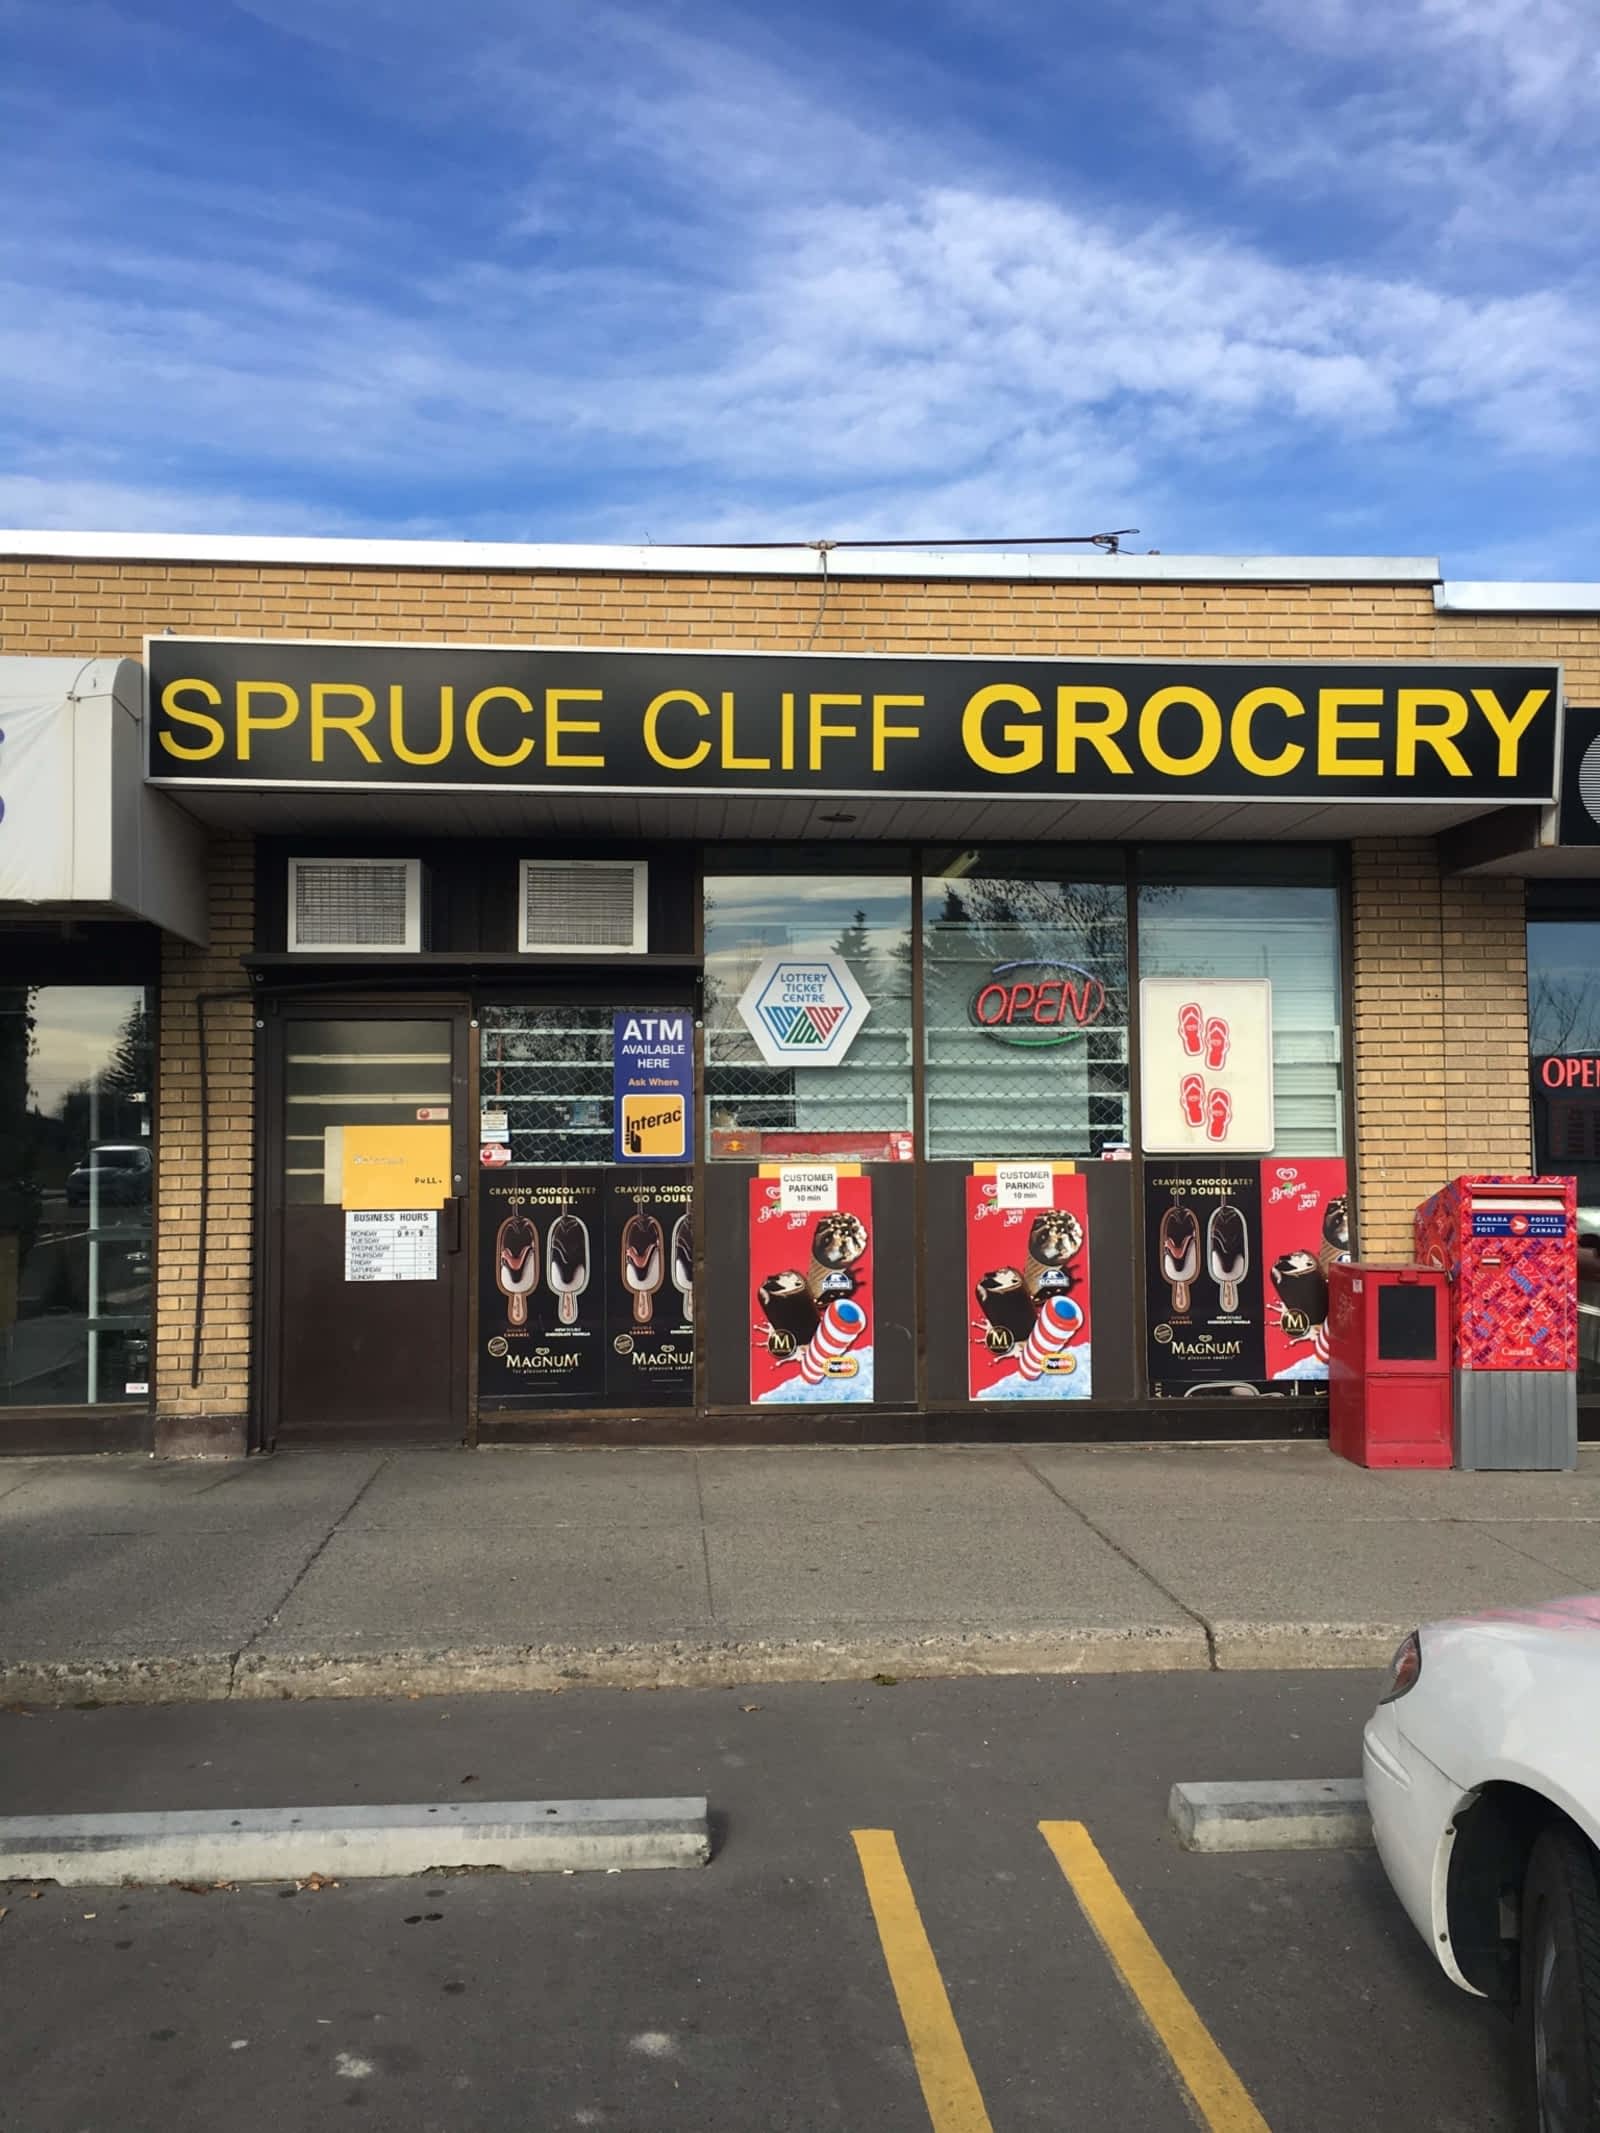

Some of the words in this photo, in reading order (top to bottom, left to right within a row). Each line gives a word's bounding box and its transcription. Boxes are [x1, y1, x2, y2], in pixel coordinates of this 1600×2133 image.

[158, 677, 605, 767] SPRUCE
[642, 689, 926, 772] CLIFF
[961, 683, 1551, 777] GROCERY
[780, 973, 828, 983] LOTTERY
[785, 983, 824, 993] TICKET
[781, 993, 826, 1003] CENTRE
[975, 979, 1093, 1025] OPEN
[622, 1018, 683, 1041] ATM
[621, 1044, 686, 1055] AVAILABLE
[637, 1058, 670, 1069] HERE
[1542, 1057, 1600, 1088] OPE
[627, 1077, 647, 1087] Ask
[649, 1077, 680, 1087] Where
[625, 1108, 682, 1134] Interac
[783, 1173, 834, 1182] CUSTOMER
[1000, 1171, 1050, 1180] CUSTOMER
[1005, 1181, 1045, 1190] PARKING
[1152, 1178, 1193, 1187] CRAVING
[1195, 1178, 1254, 1186] CHOCOLATE?
[489, 1187, 533, 1196] CRAVING
[535, 1186, 597, 1195] CHOCOLATE?
[614, 1185, 657, 1194] CRAVING
[788, 1184, 829, 1192] PARKING
[1169, 1187, 1186, 1196] GO
[1190, 1186, 1237, 1196] DOUBLE.
[507, 1196, 526, 1205] GO
[529, 1195, 579, 1205] DOUBLE.
[632, 1194, 651, 1204] GO
[797, 1194, 806, 1202] 10
[1014, 1192, 1022, 1200] 10
[353, 1213, 395, 1222] BUSINESS
[400, 1213, 429, 1222] HOURS
[1171, 1340, 1241, 1355] MAGNUM
[506, 1352, 580, 1368] MAGNUM
